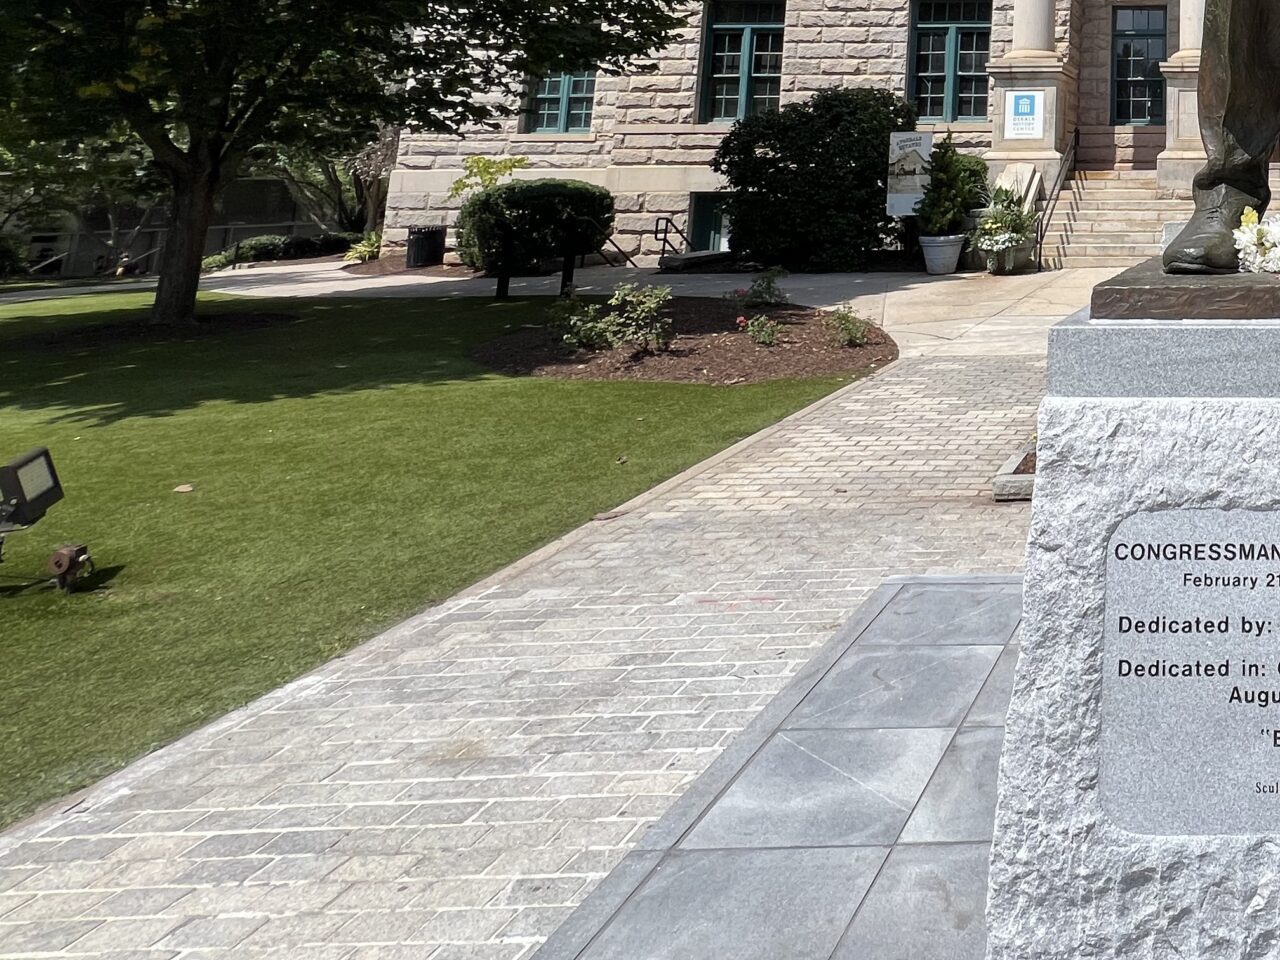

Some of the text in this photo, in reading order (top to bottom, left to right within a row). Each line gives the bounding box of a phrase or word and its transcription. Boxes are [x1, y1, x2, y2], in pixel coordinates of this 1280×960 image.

[1183, 572, 1259, 591] February
[1118, 615, 1229, 634] Dedicated
[1241, 615, 1272, 638] by:
[1118, 659, 1230, 678] Dedicated
[1241, 659, 1266, 677] in:
